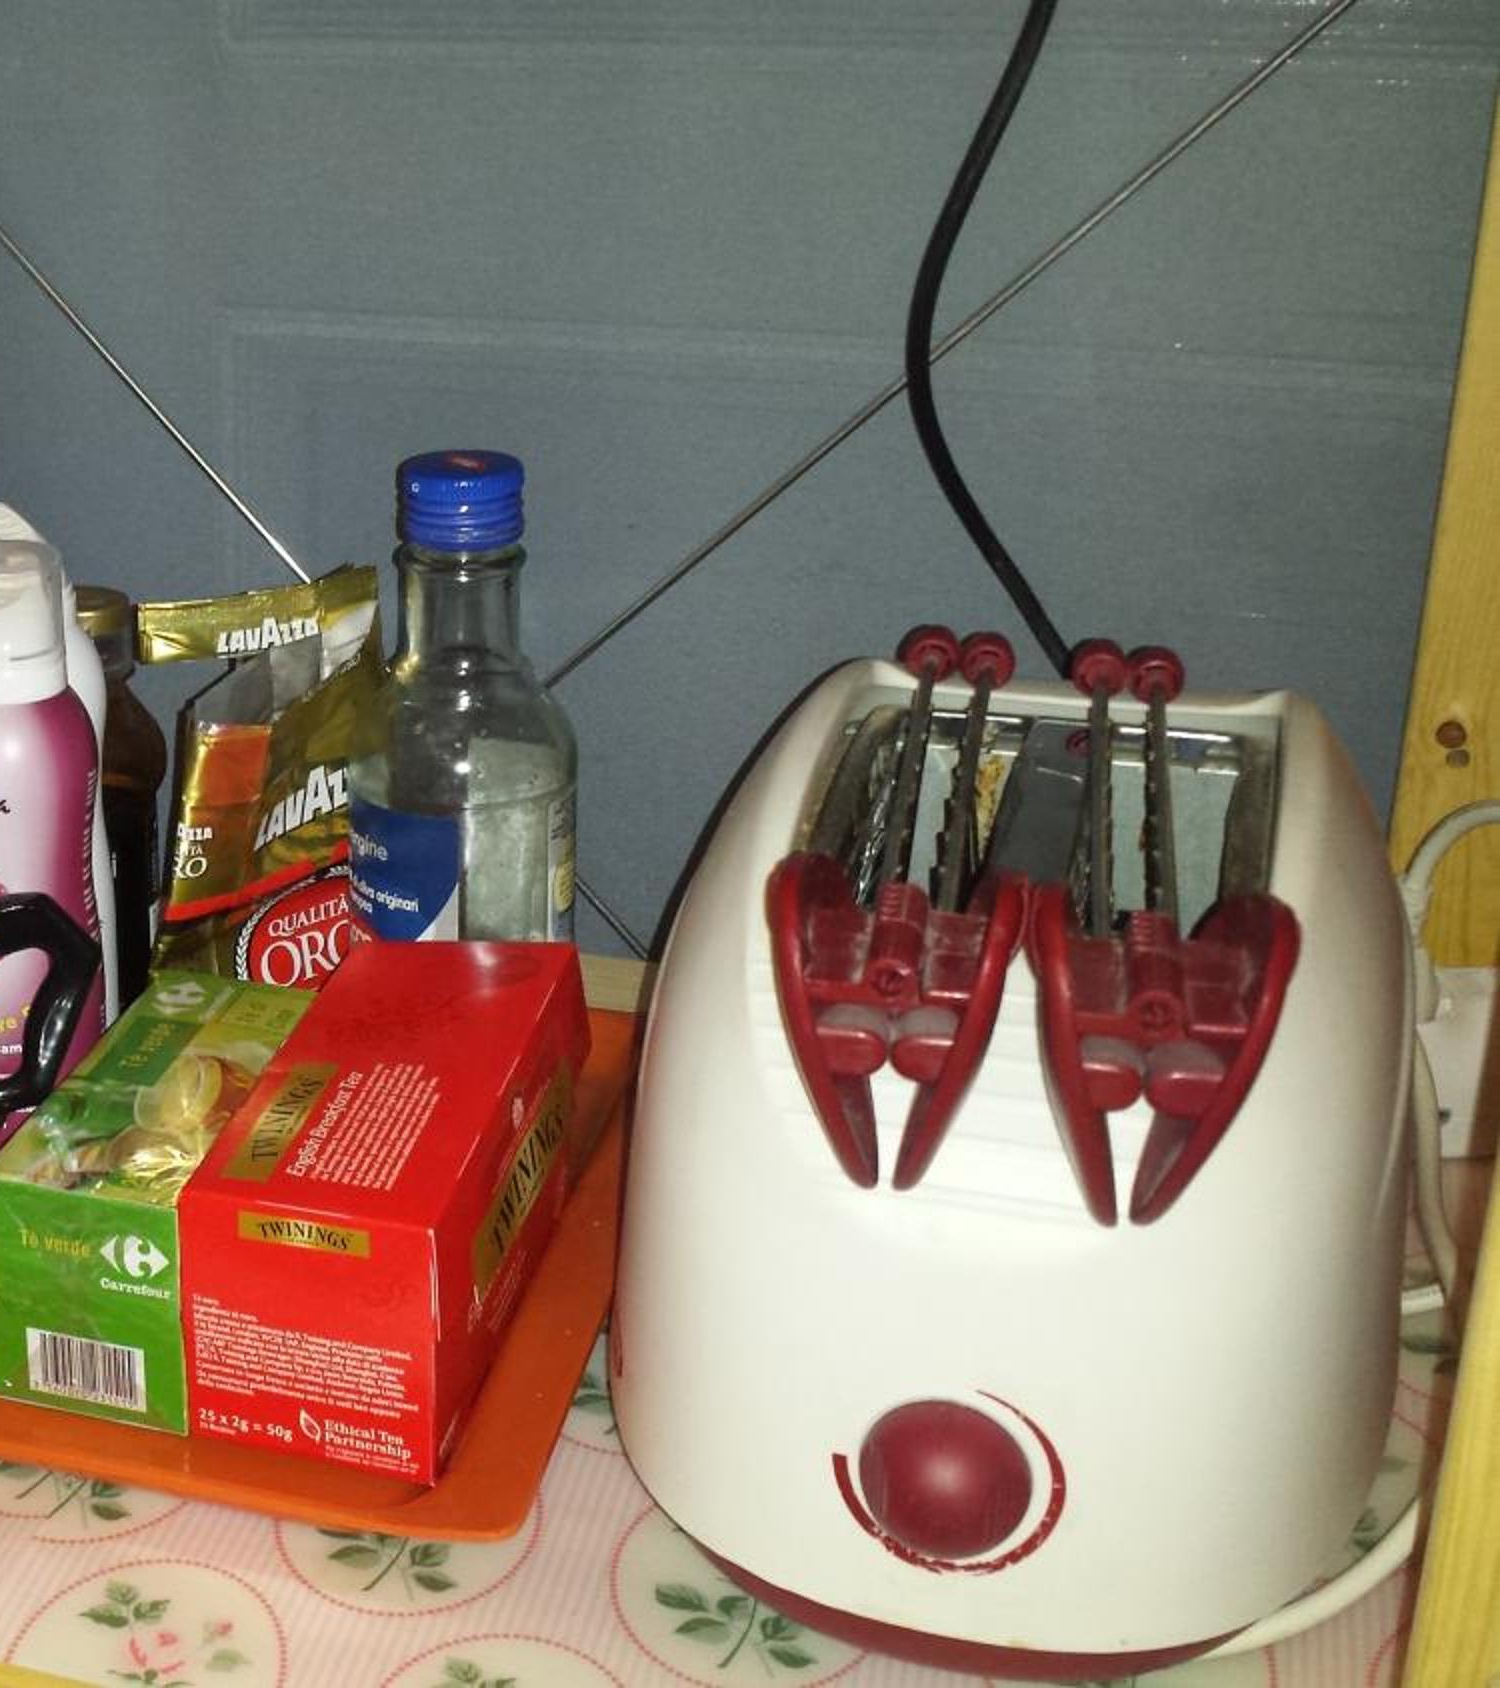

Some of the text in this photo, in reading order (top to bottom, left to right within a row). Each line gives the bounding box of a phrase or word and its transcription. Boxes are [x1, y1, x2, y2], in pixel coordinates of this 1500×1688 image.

[217, 615, 319, 654] LAVAZZA
[254, 764, 350, 851] LAVAZ
[268, 893, 349, 937] QUALITÀ
[252, 1074, 326, 1161] TWININGS
[286, 1139, 321, 1177] English
[308, 1091, 353, 1139] Breakfast
[45, 1234, 91, 1258] verde
[258, 1220, 349, 1250] TWININGS
[101, 1277, 171, 1299] Carrefour
[199, 1407, 215, 1422] 25
[219, 1413, 228, 1425] x
[232, 1415, 249, 1433] 2g
[265, 1423, 293, 1442] 50g
[324, 1419, 376, 1441] Ethical
[325, 1431, 412, 1461] Partnership
